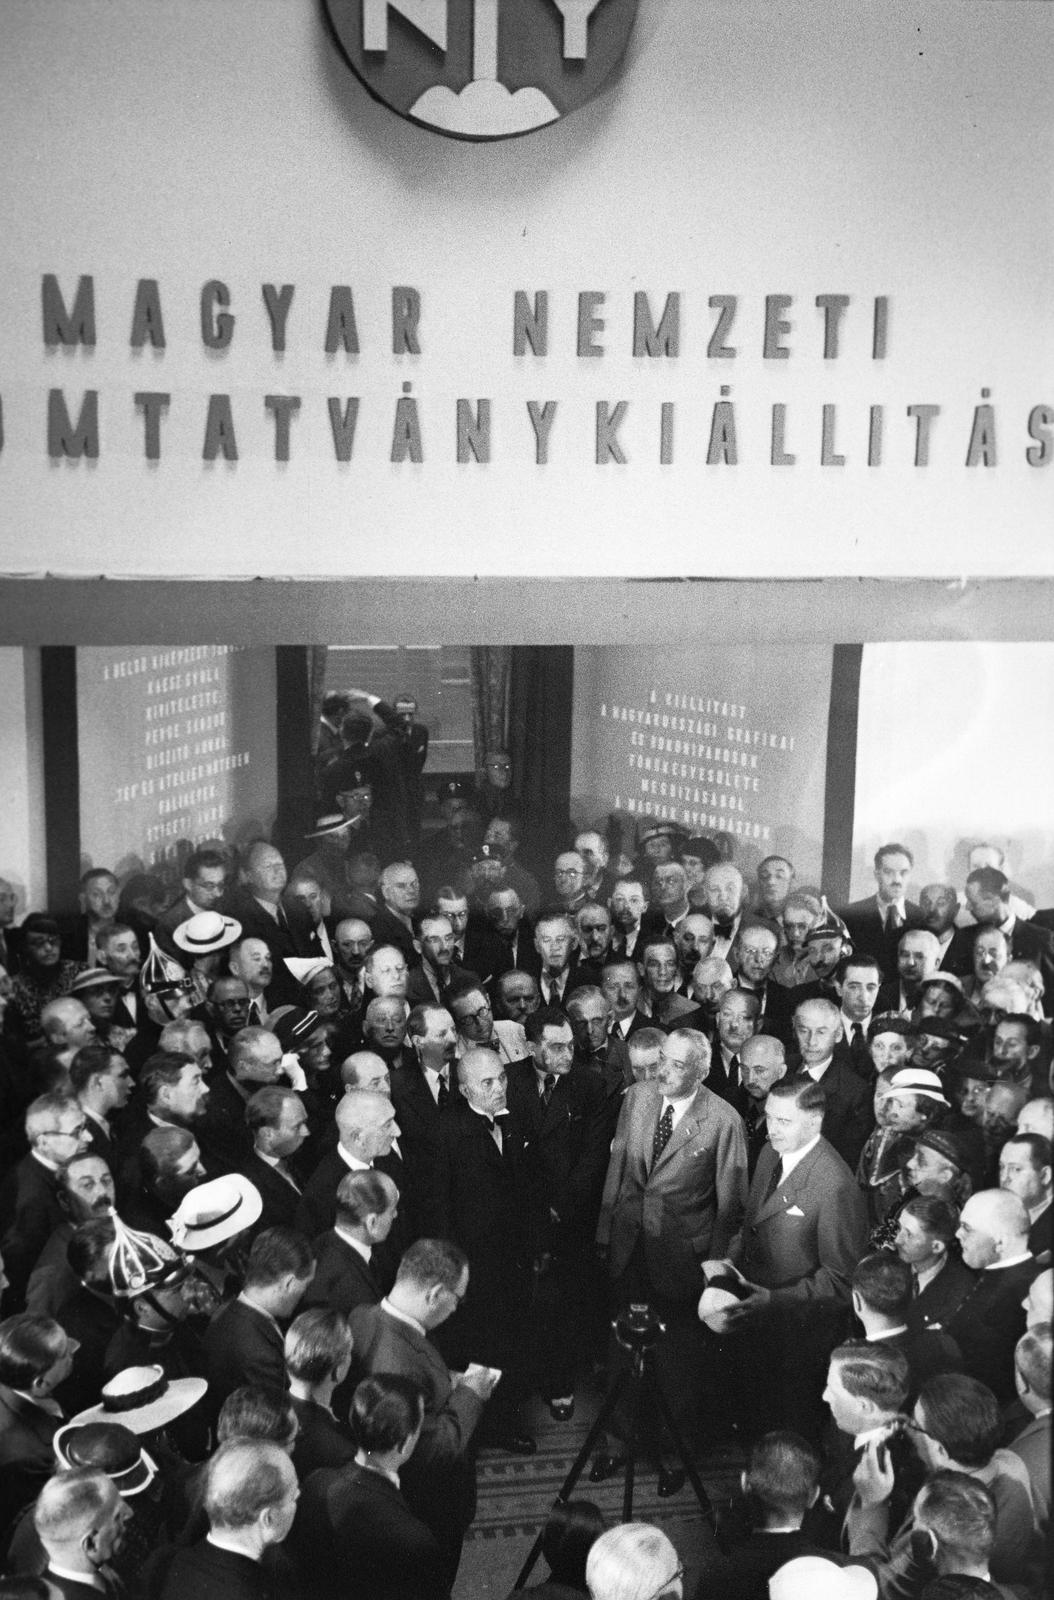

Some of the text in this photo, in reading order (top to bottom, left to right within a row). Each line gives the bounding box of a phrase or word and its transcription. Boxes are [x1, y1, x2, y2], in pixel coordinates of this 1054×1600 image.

[42, 273, 888, 360] MAGYAR NEMZETI
[0, 381, 1054, 467] MTATVÁNYKIÁLLITÁS
